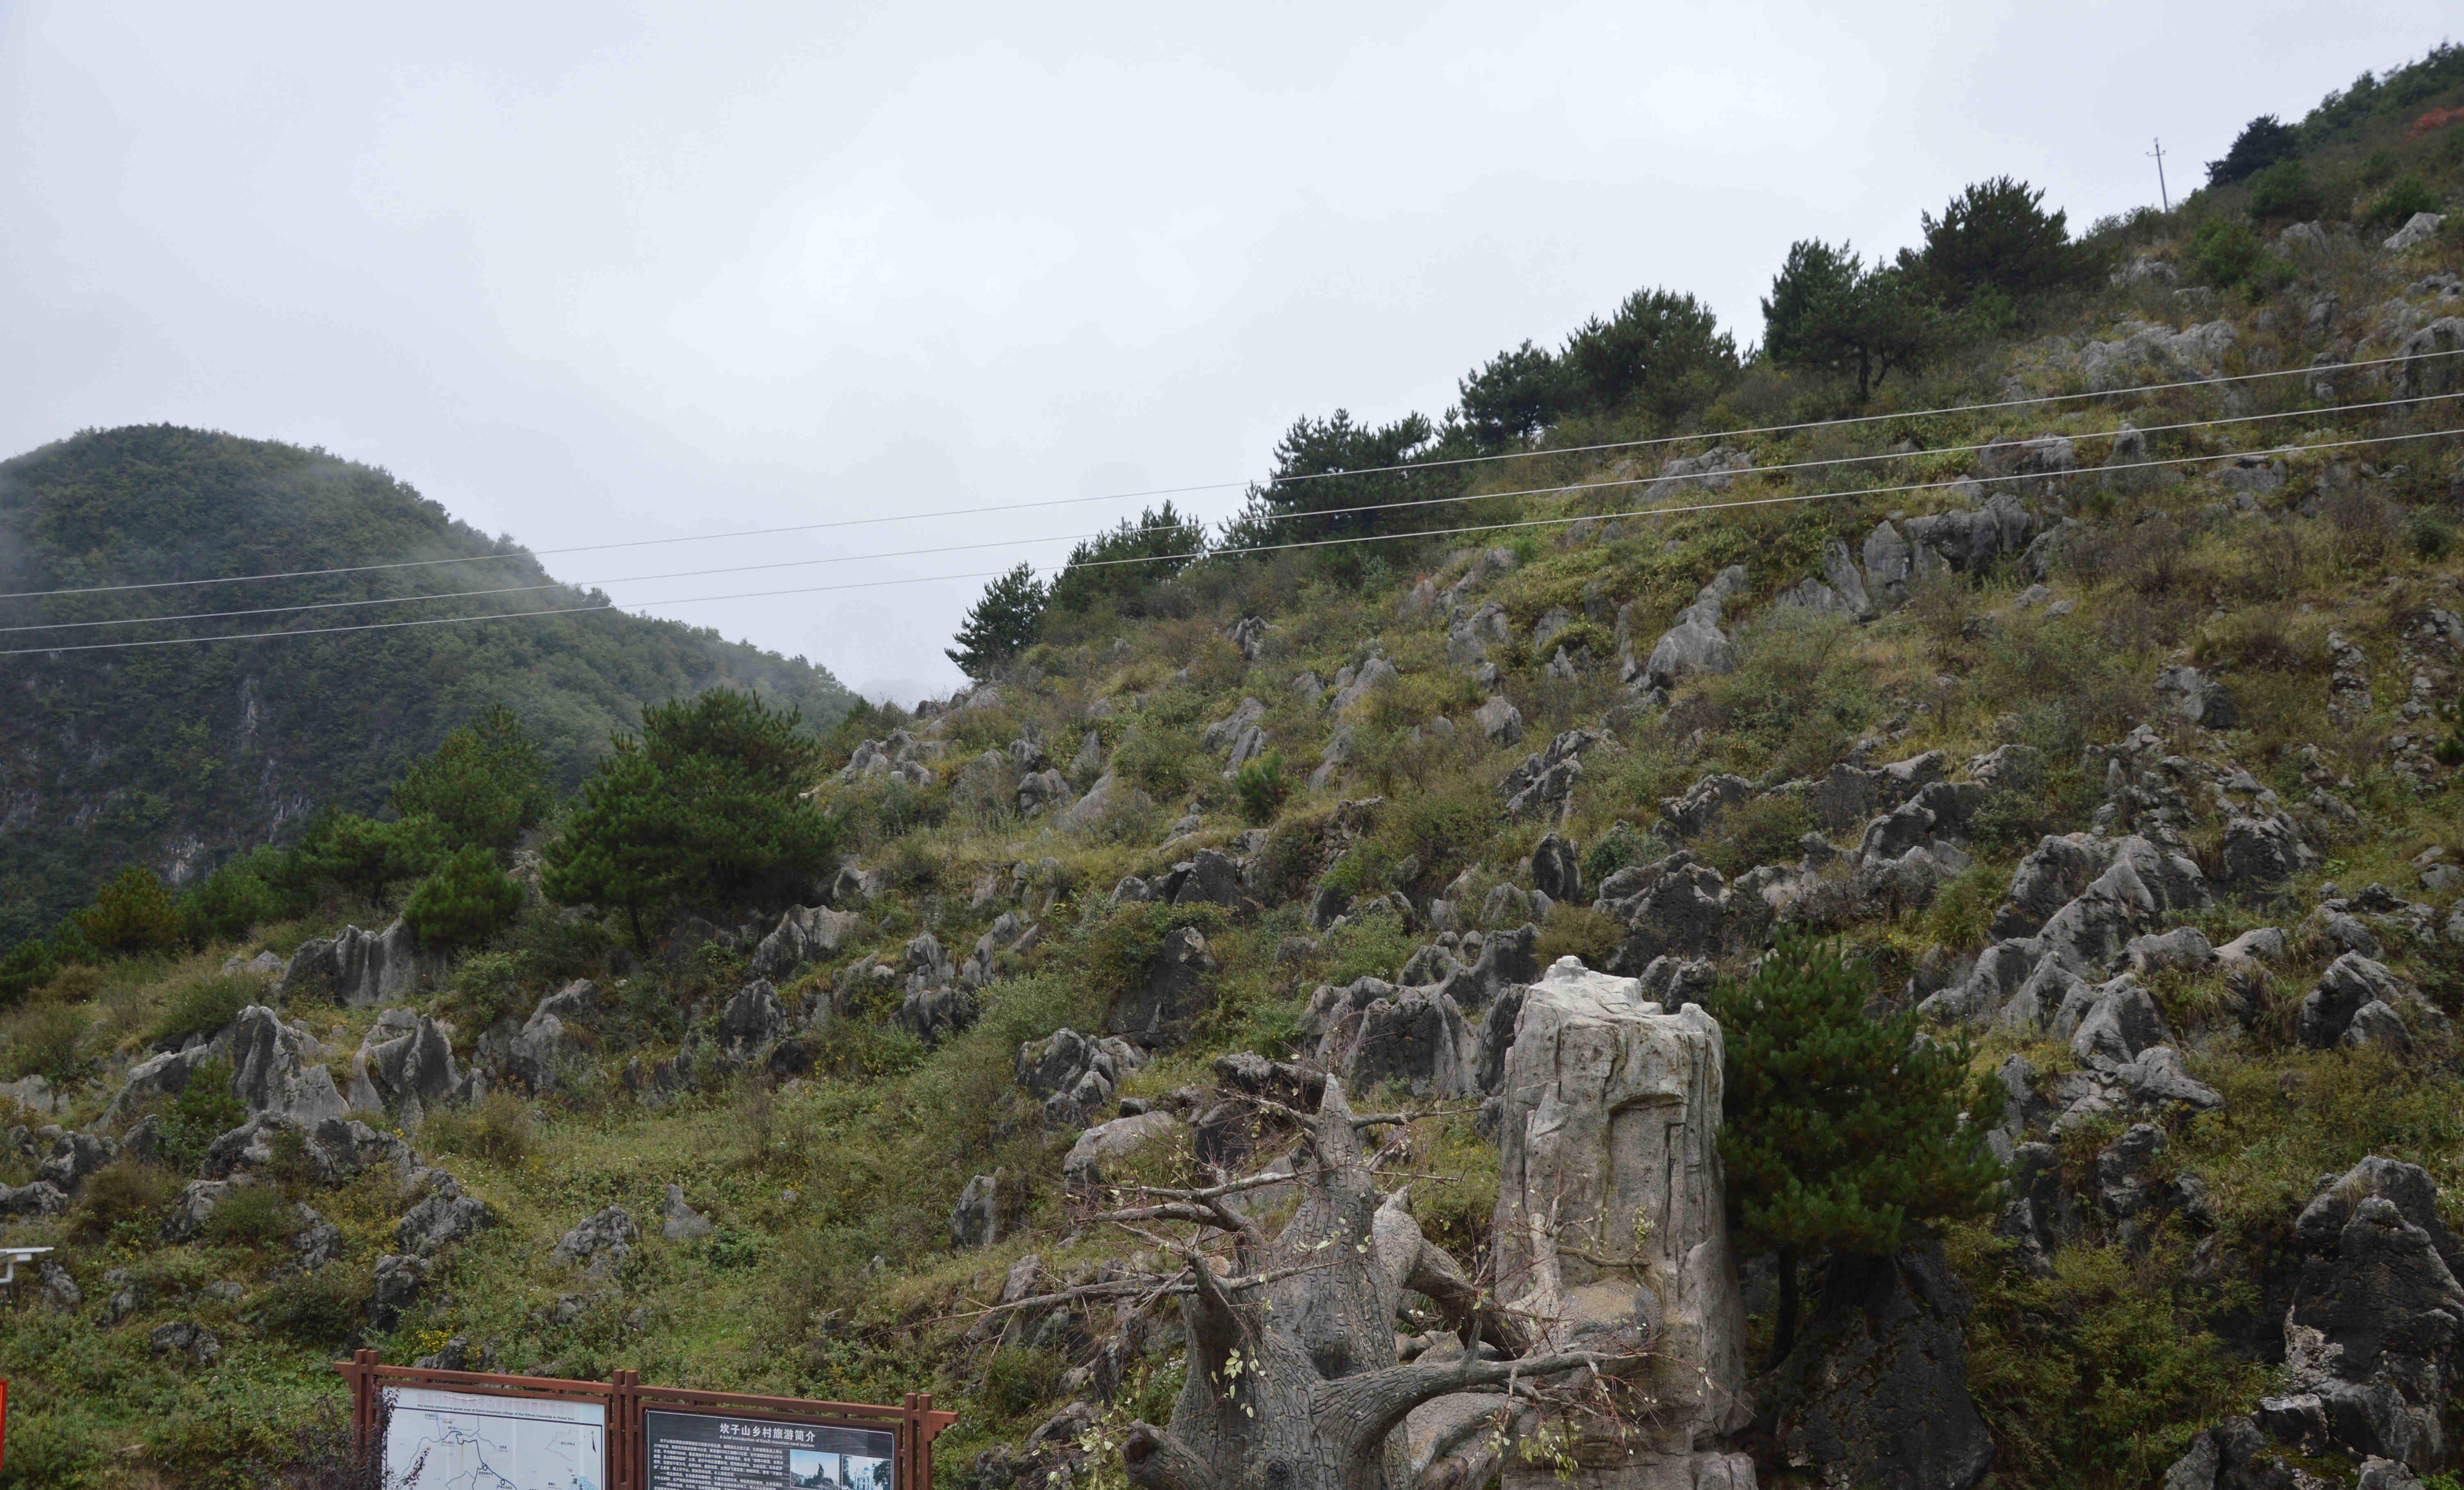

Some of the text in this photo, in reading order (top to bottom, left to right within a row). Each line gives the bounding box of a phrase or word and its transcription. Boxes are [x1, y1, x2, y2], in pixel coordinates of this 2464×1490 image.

[720, 1423, 815, 1442] 坎子山乡村旅游简介
